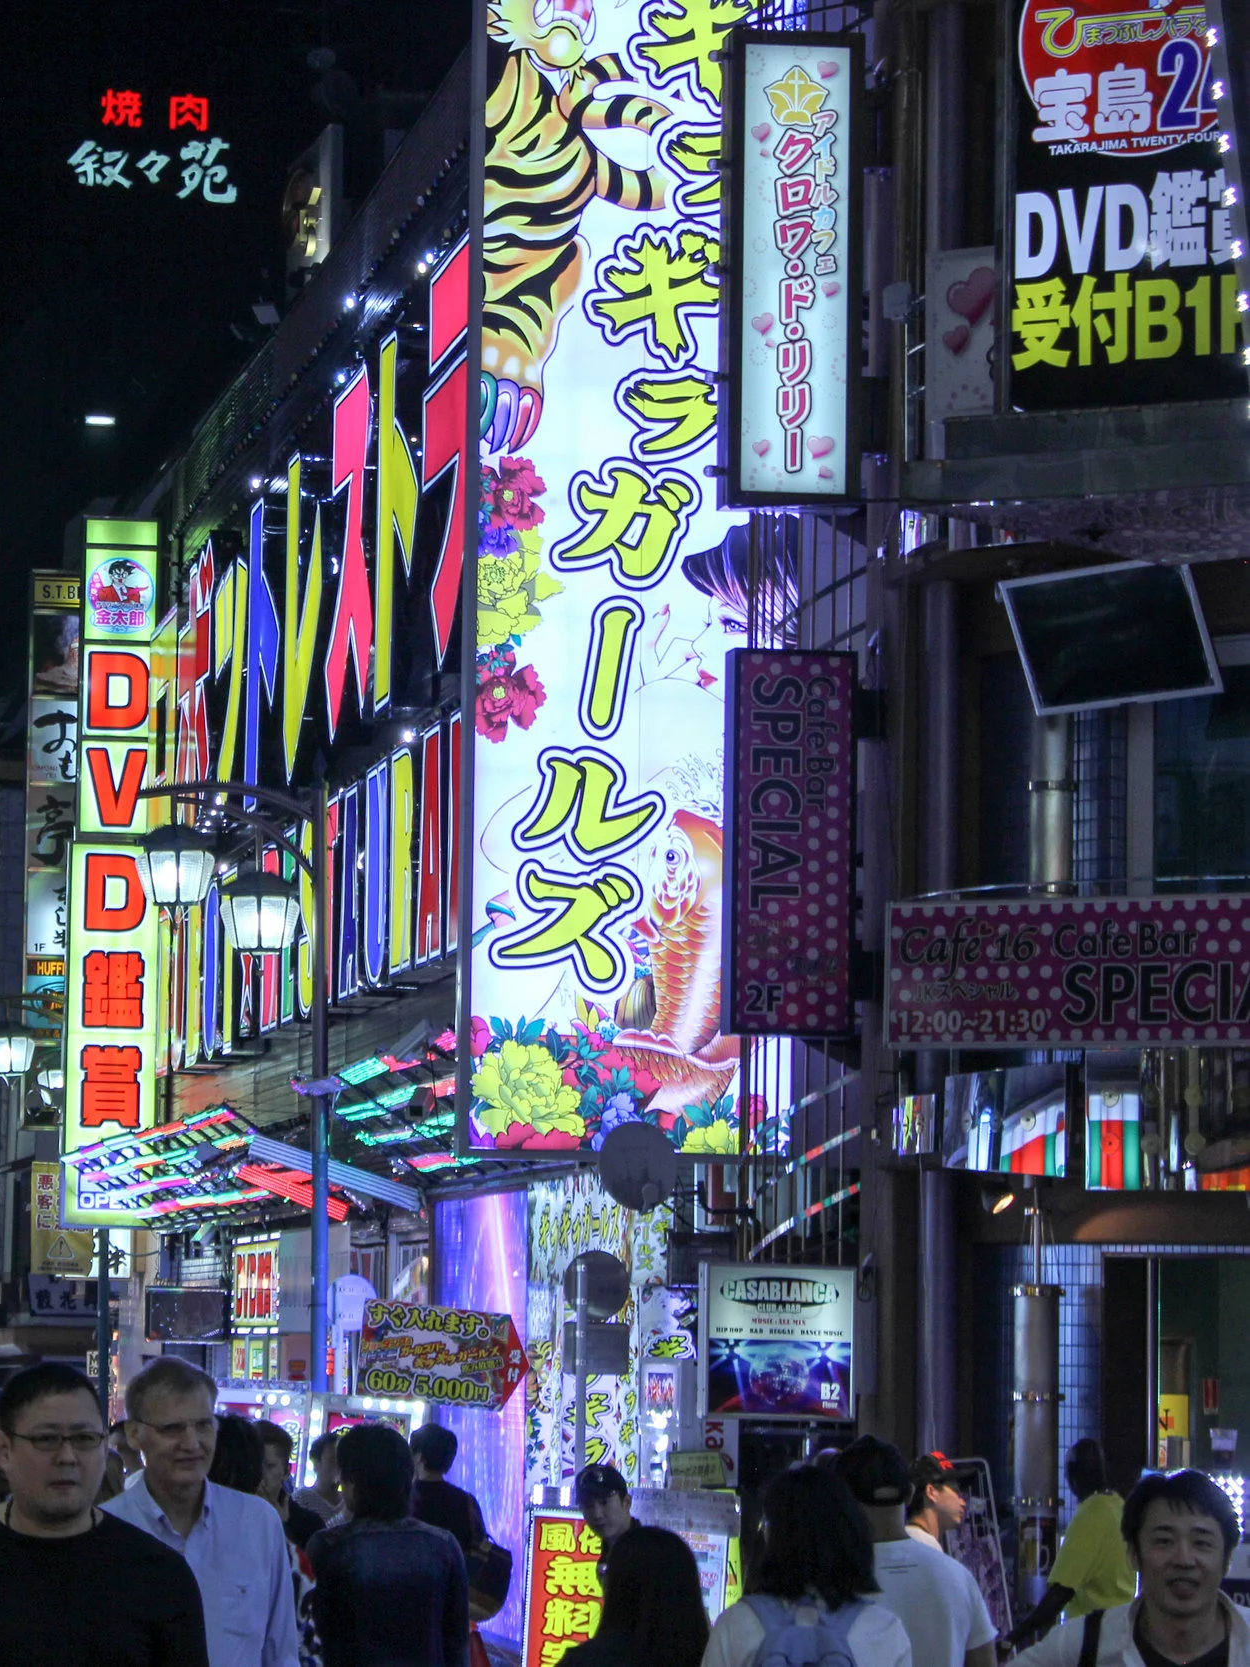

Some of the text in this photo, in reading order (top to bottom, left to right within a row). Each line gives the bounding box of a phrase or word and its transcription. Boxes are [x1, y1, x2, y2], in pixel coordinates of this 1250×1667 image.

[101, 88, 208, 131] 焼肉
[1049, 138, 1128, 156] TAKARAJIMA
[1132, 134, 1183, 149] TWENTY
[67, 137, 238, 204] 叙々苑
[810, 109, 839, 277] アイドルカフェ
[95, 609, 145, 627] 金太郎
[750, 673, 804, 912] SPECIAL
[34, 942, 47, 953] 1F
[992, 926, 1041, 963] 16
[1052, 918, 1200, 960] Cafe Bar
[744, 983, 784, 1015] 2F
[722, 1280, 838, 1304] CASABLANCA
[367, 1302, 491, 1340] すぐ入れます。
[366, 1369, 491, 1402] 60分 5,000円
[820, 1382, 840, 1401] B2
